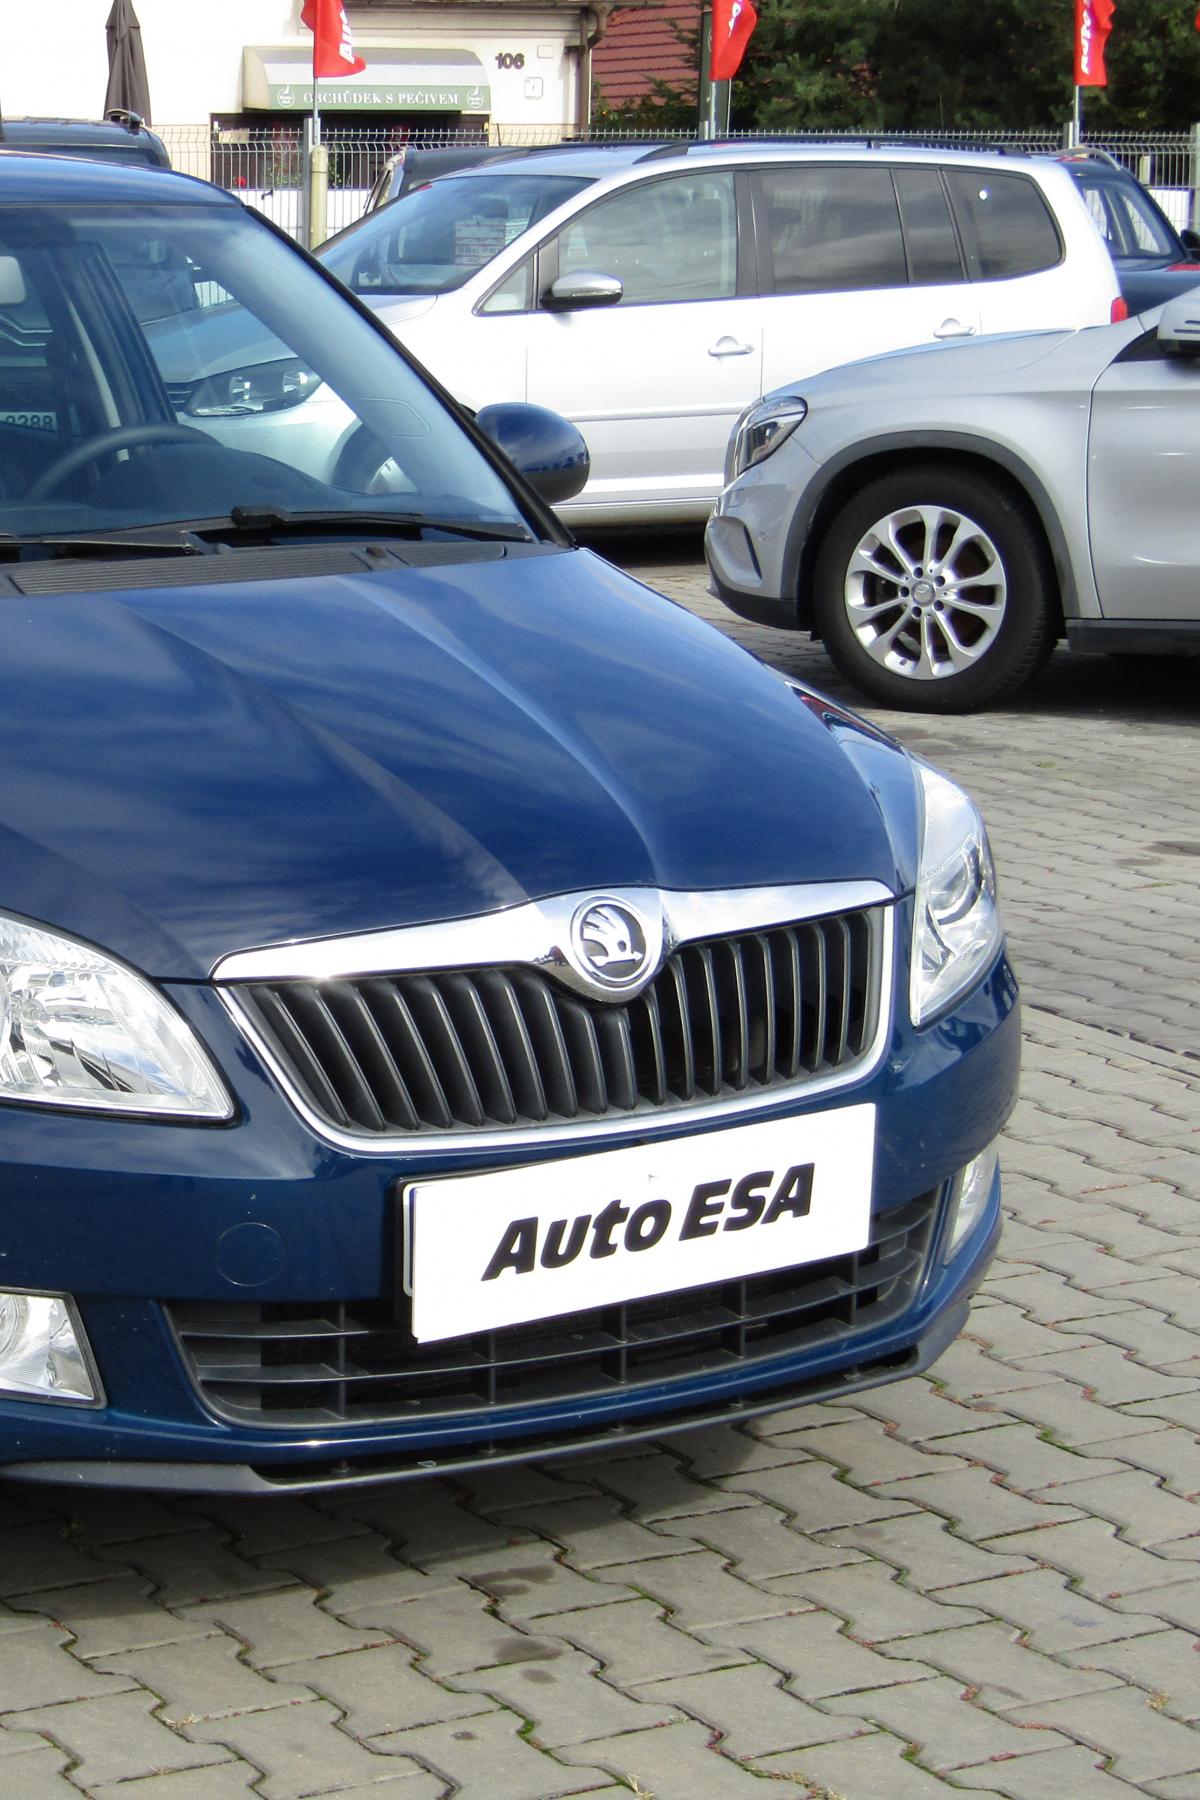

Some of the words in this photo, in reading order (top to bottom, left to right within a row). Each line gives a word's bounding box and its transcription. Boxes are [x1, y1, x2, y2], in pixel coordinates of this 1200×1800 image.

[495, 53, 525, 70] 106
[385, 93, 394, 104] S
[398, 91, 459, 105] PEČIVEM
[480, 1199, 673, 1282] Auto
[678, 1162, 816, 1242] ESA
